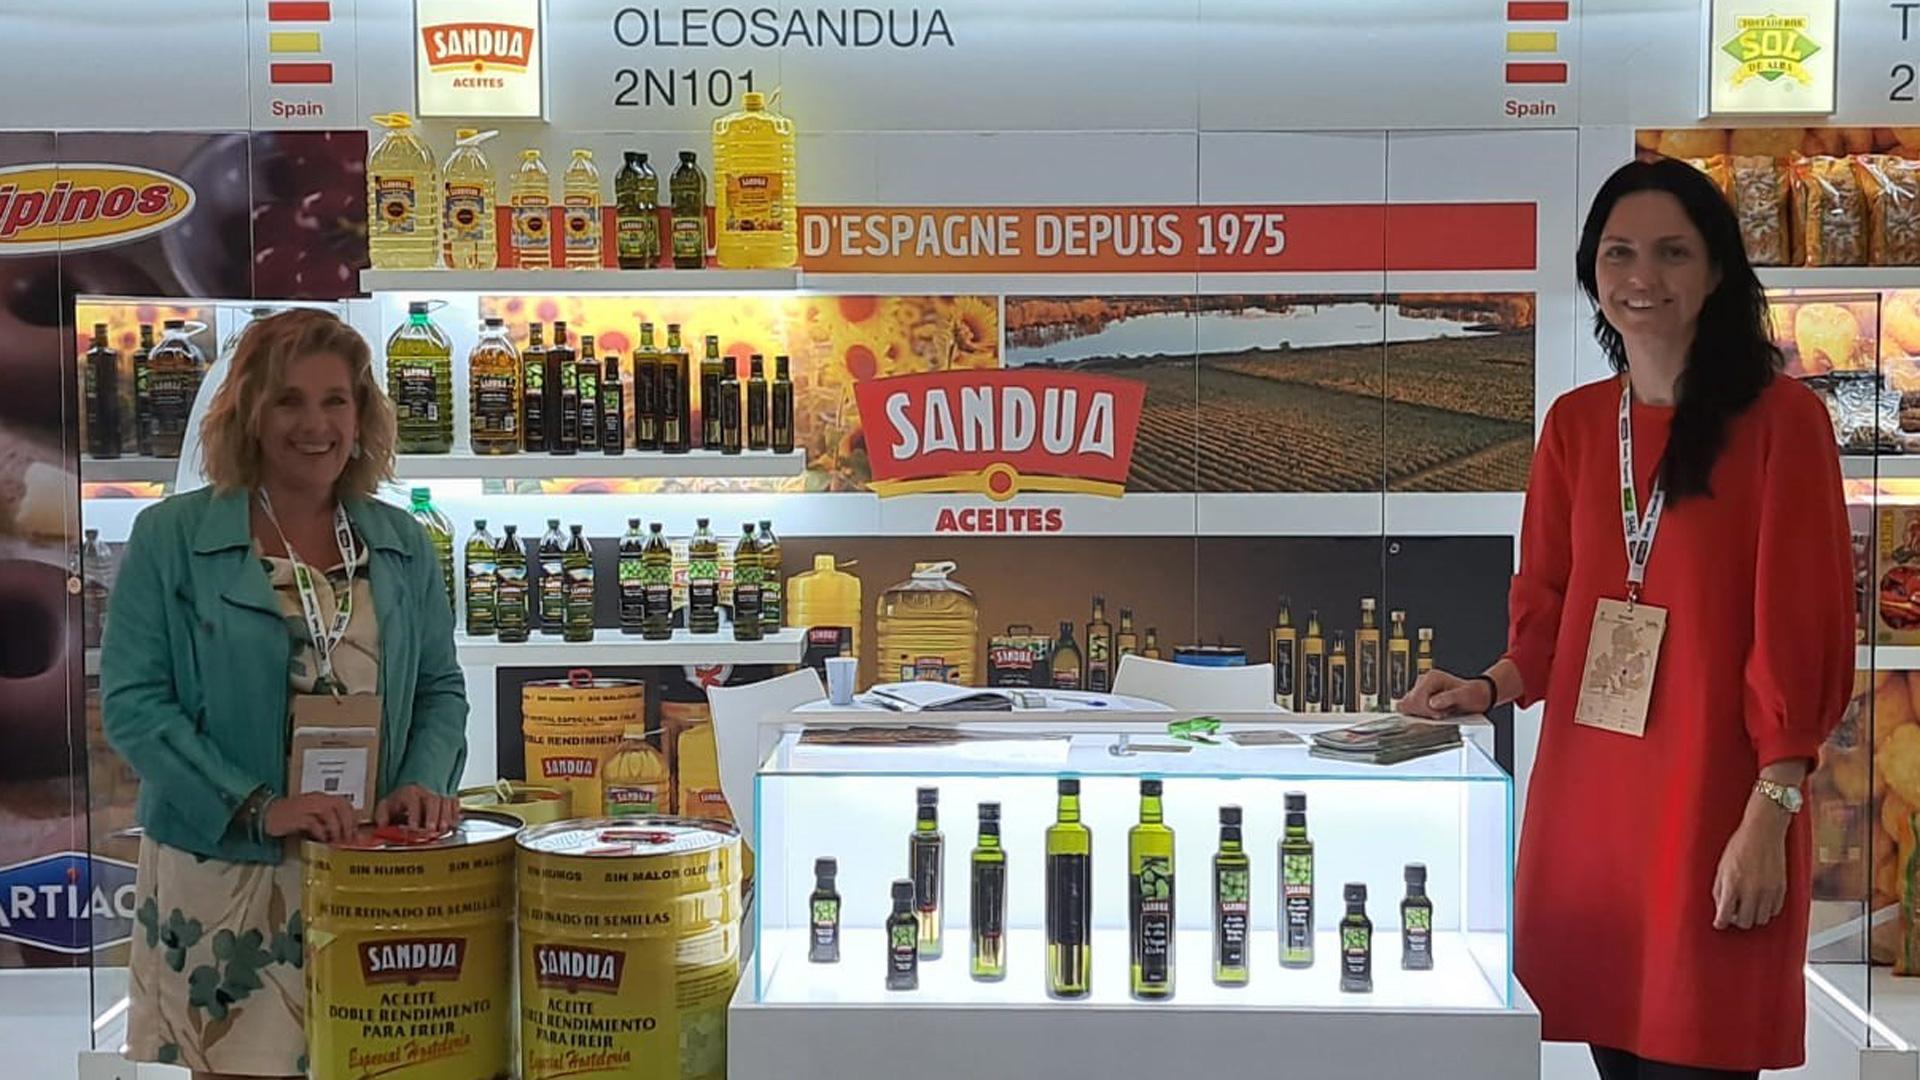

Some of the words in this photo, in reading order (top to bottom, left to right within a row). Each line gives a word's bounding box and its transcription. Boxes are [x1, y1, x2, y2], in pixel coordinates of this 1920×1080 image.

[613, 8, 955, 47] OLEOSANDUA
[433, 28, 524, 60] SANDUA
[1739, 30, 1802, 60] SOL
[452, 78, 504, 89] ACEITES
[614, 69, 754, 107] 2N101
[1889, 64, 1915, 101] 2
[272, 100, 324, 119] Spain
[1505, 100, 1556, 118] Spain
[802, 214, 1021, 257] D'ESPAGNE
[1035, 214, 1183, 257] DEPUIS
[1197, 213, 1286, 255] 1975
[886, 385, 1115, 460] SANDUA
[935, 508, 1063, 533] ACEITES
[545, 758, 593, 775] SANDUA
[349, 864, 370, 875] SIN
[374, 864, 425, 875] HUMOS
[604, 872, 629, 883] SIN
[632, 867, 680, 882] MALOS
[427, 905, 443, 917] DE
[603, 912, 671, 928] SEMILLAS
[367, 943, 458, 973] SANDUA
[539, 950, 615, 980] SANDUA
[380, 991, 437, 1006] ACEITE
[547, 998, 593, 1015] ACEITE
[328, 1005, 375, 1022] DOBLE
[379, 999, 491, 1022] RENDIMIENTO
[362, 1024, 405, 1038] PARA
[410, 1020, 456, 1037] FREIR
[546, 1013, 656, 1033] RENDIMIENTO
[536, 1027, 566, 1046] PARA
[570, 1033, 614, 1049] FREIR
